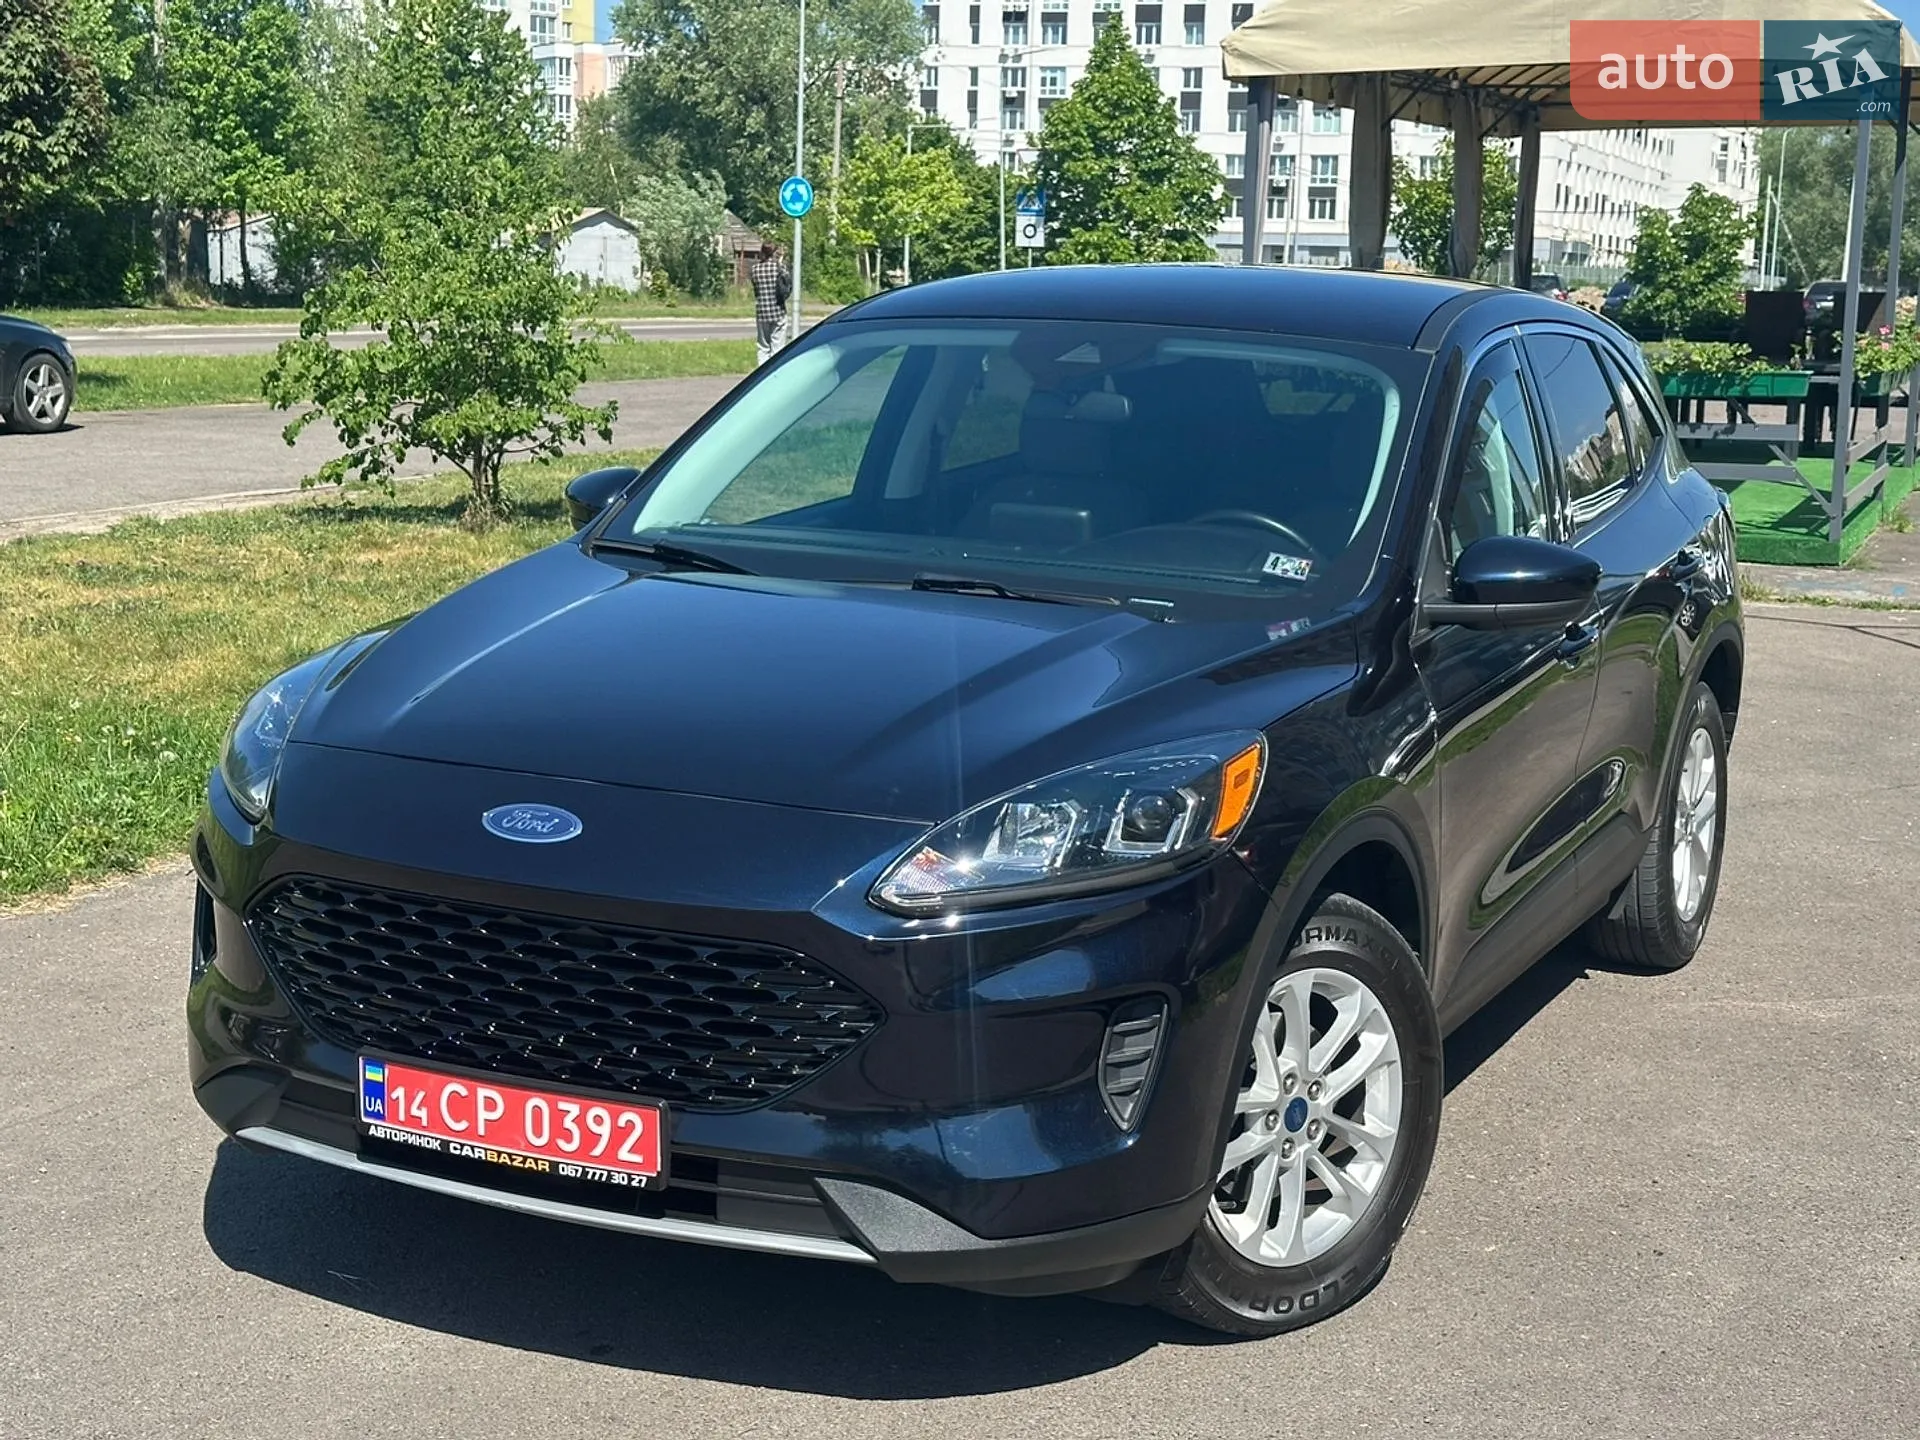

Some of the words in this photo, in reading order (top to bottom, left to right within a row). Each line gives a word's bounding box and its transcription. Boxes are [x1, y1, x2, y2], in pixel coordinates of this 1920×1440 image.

[501, 809, 559, 833] Ford
[365, 1095, 384, 1115] UA
[390, 1085, 428, 1127] 14
[439, 1082, 506, 1136] CP
[524, 1097, 645, 1164] 0392
[368, 1124, 441, 1151] АВТОРИНОК
[558, 1163, 583, 1178] 067
[585, 1167, 608, 1182] 777
[610, 1171, 629, 1186] 30
[630, 1175, 648, 1188] 27
